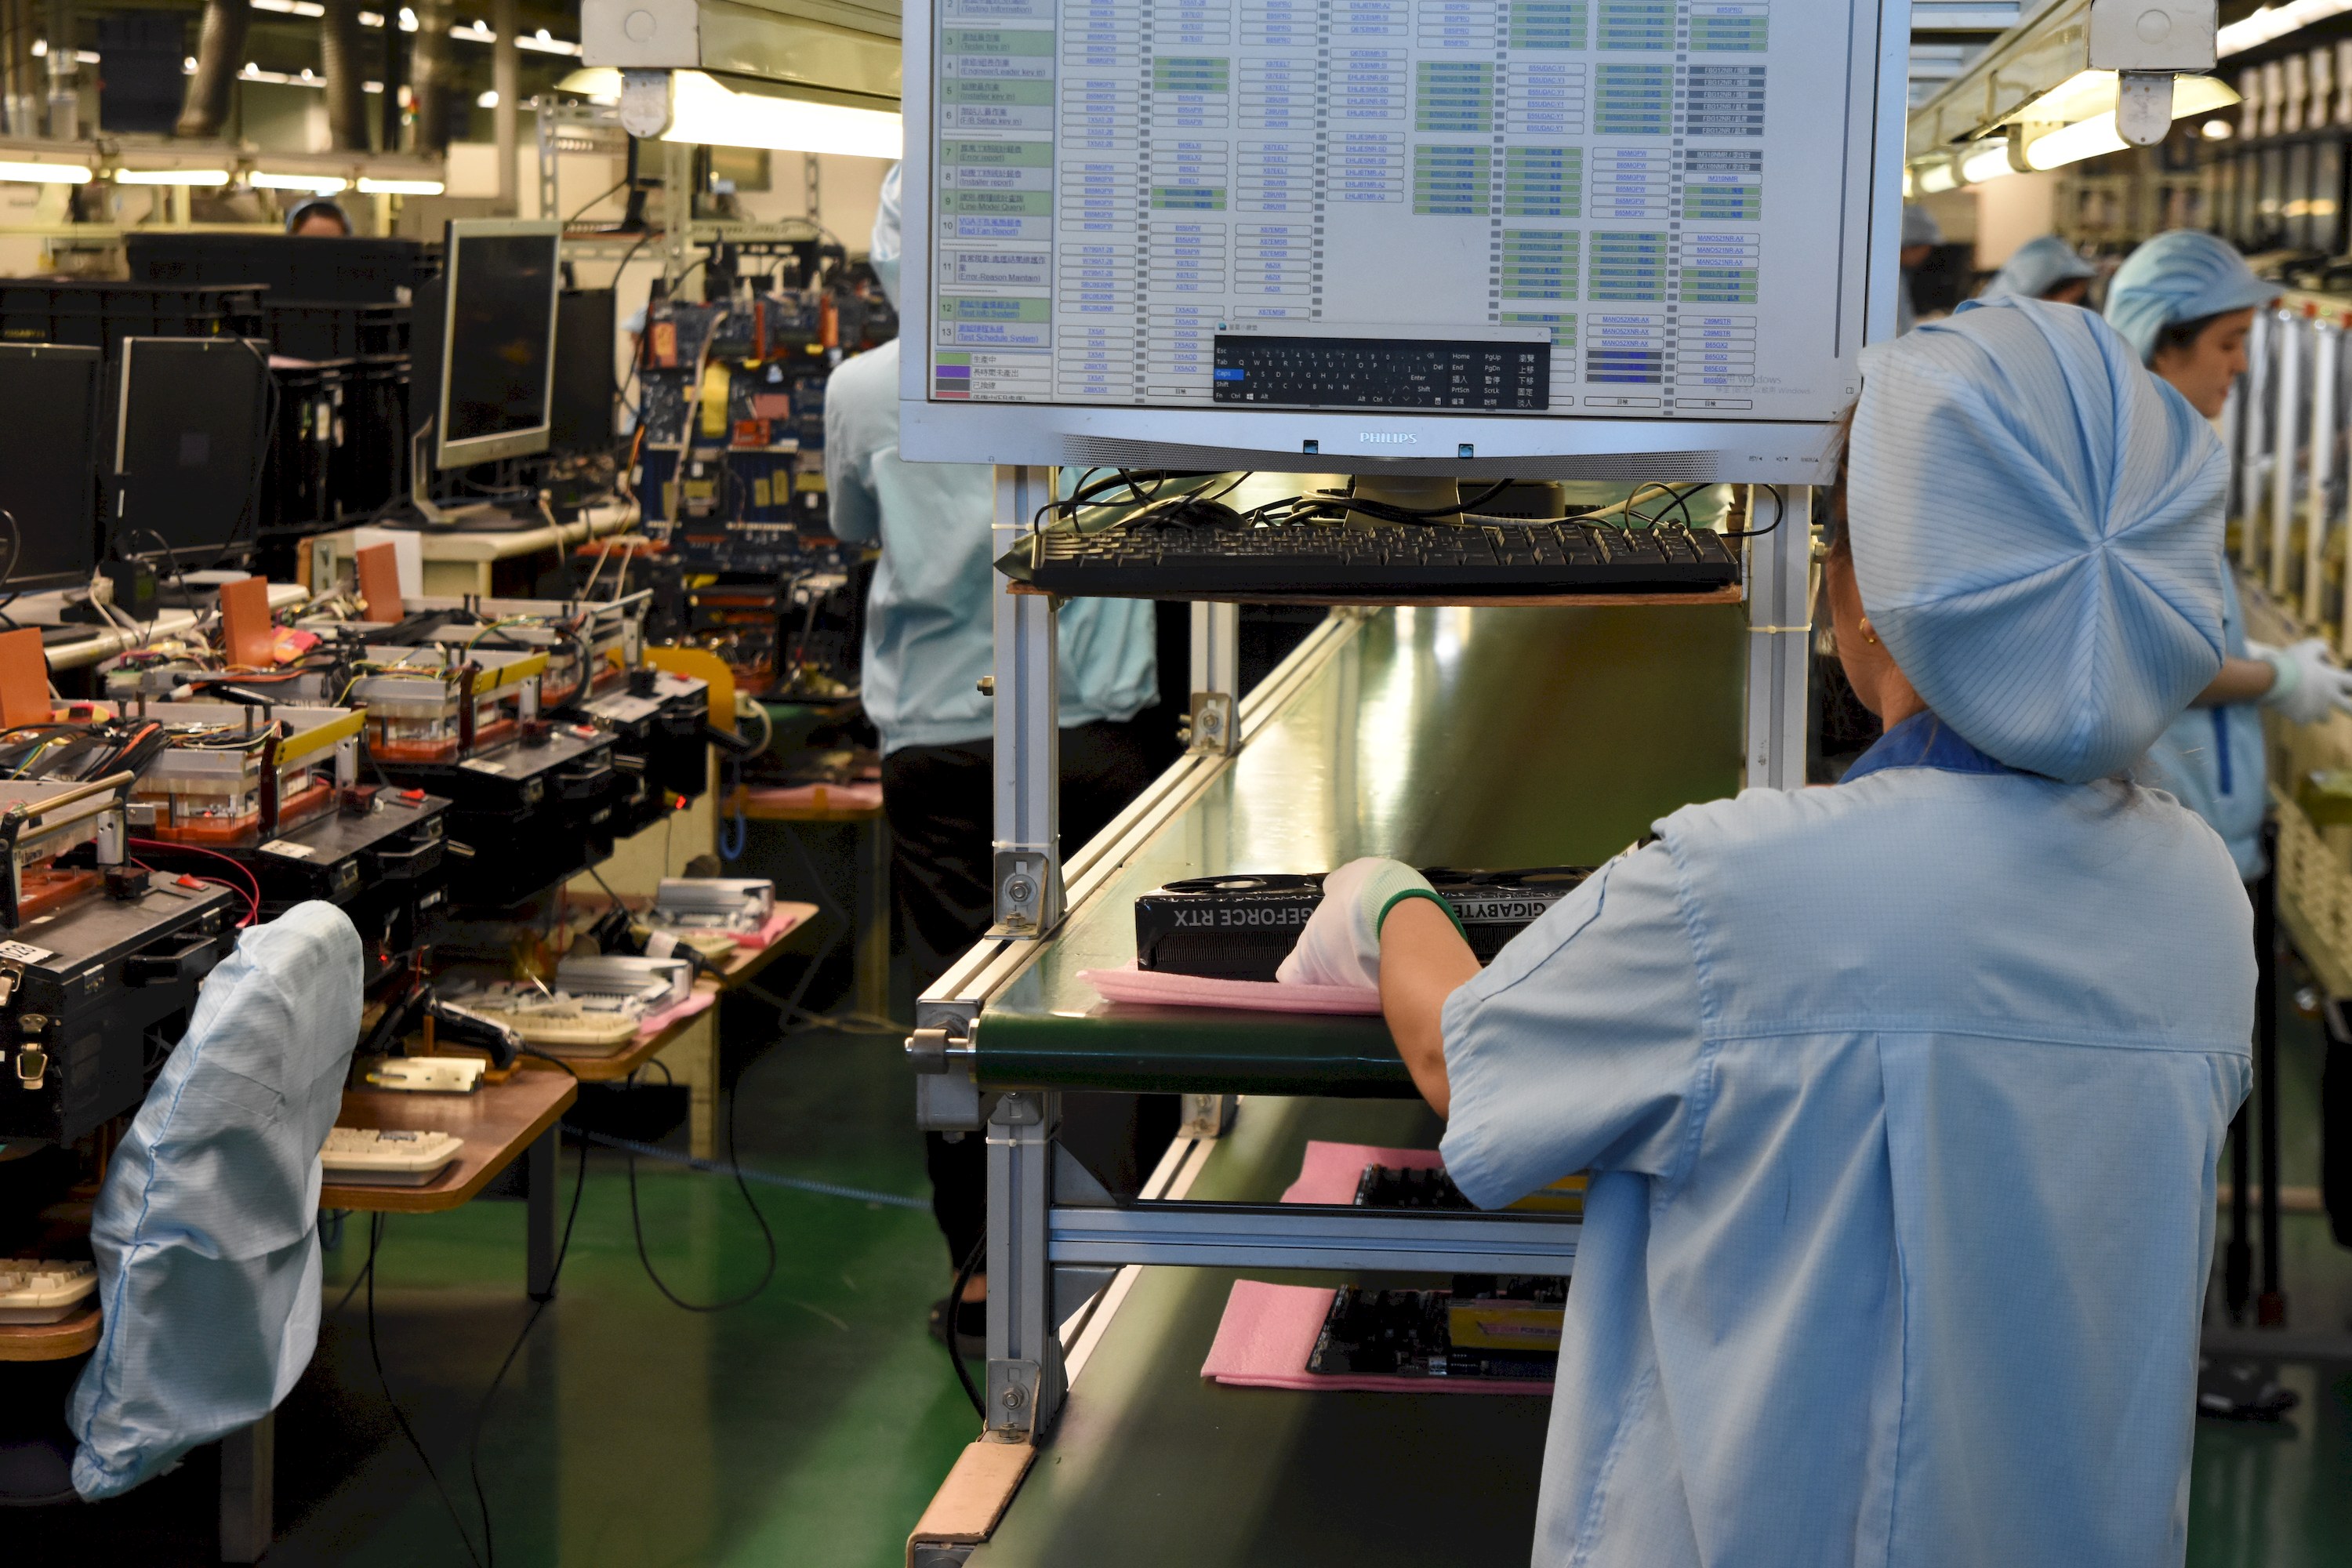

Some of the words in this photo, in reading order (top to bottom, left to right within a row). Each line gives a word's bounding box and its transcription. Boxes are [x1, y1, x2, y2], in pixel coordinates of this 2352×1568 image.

[1519, 376, 1534, 385] 下移
[1360, 432, 1417, 445] PHILIPS
[1174, 909, 1214, 927] RTX
[1220, 908, 1314, 927] GEFORCE
[1452, 902, 1546, 919] GIGABYTE
